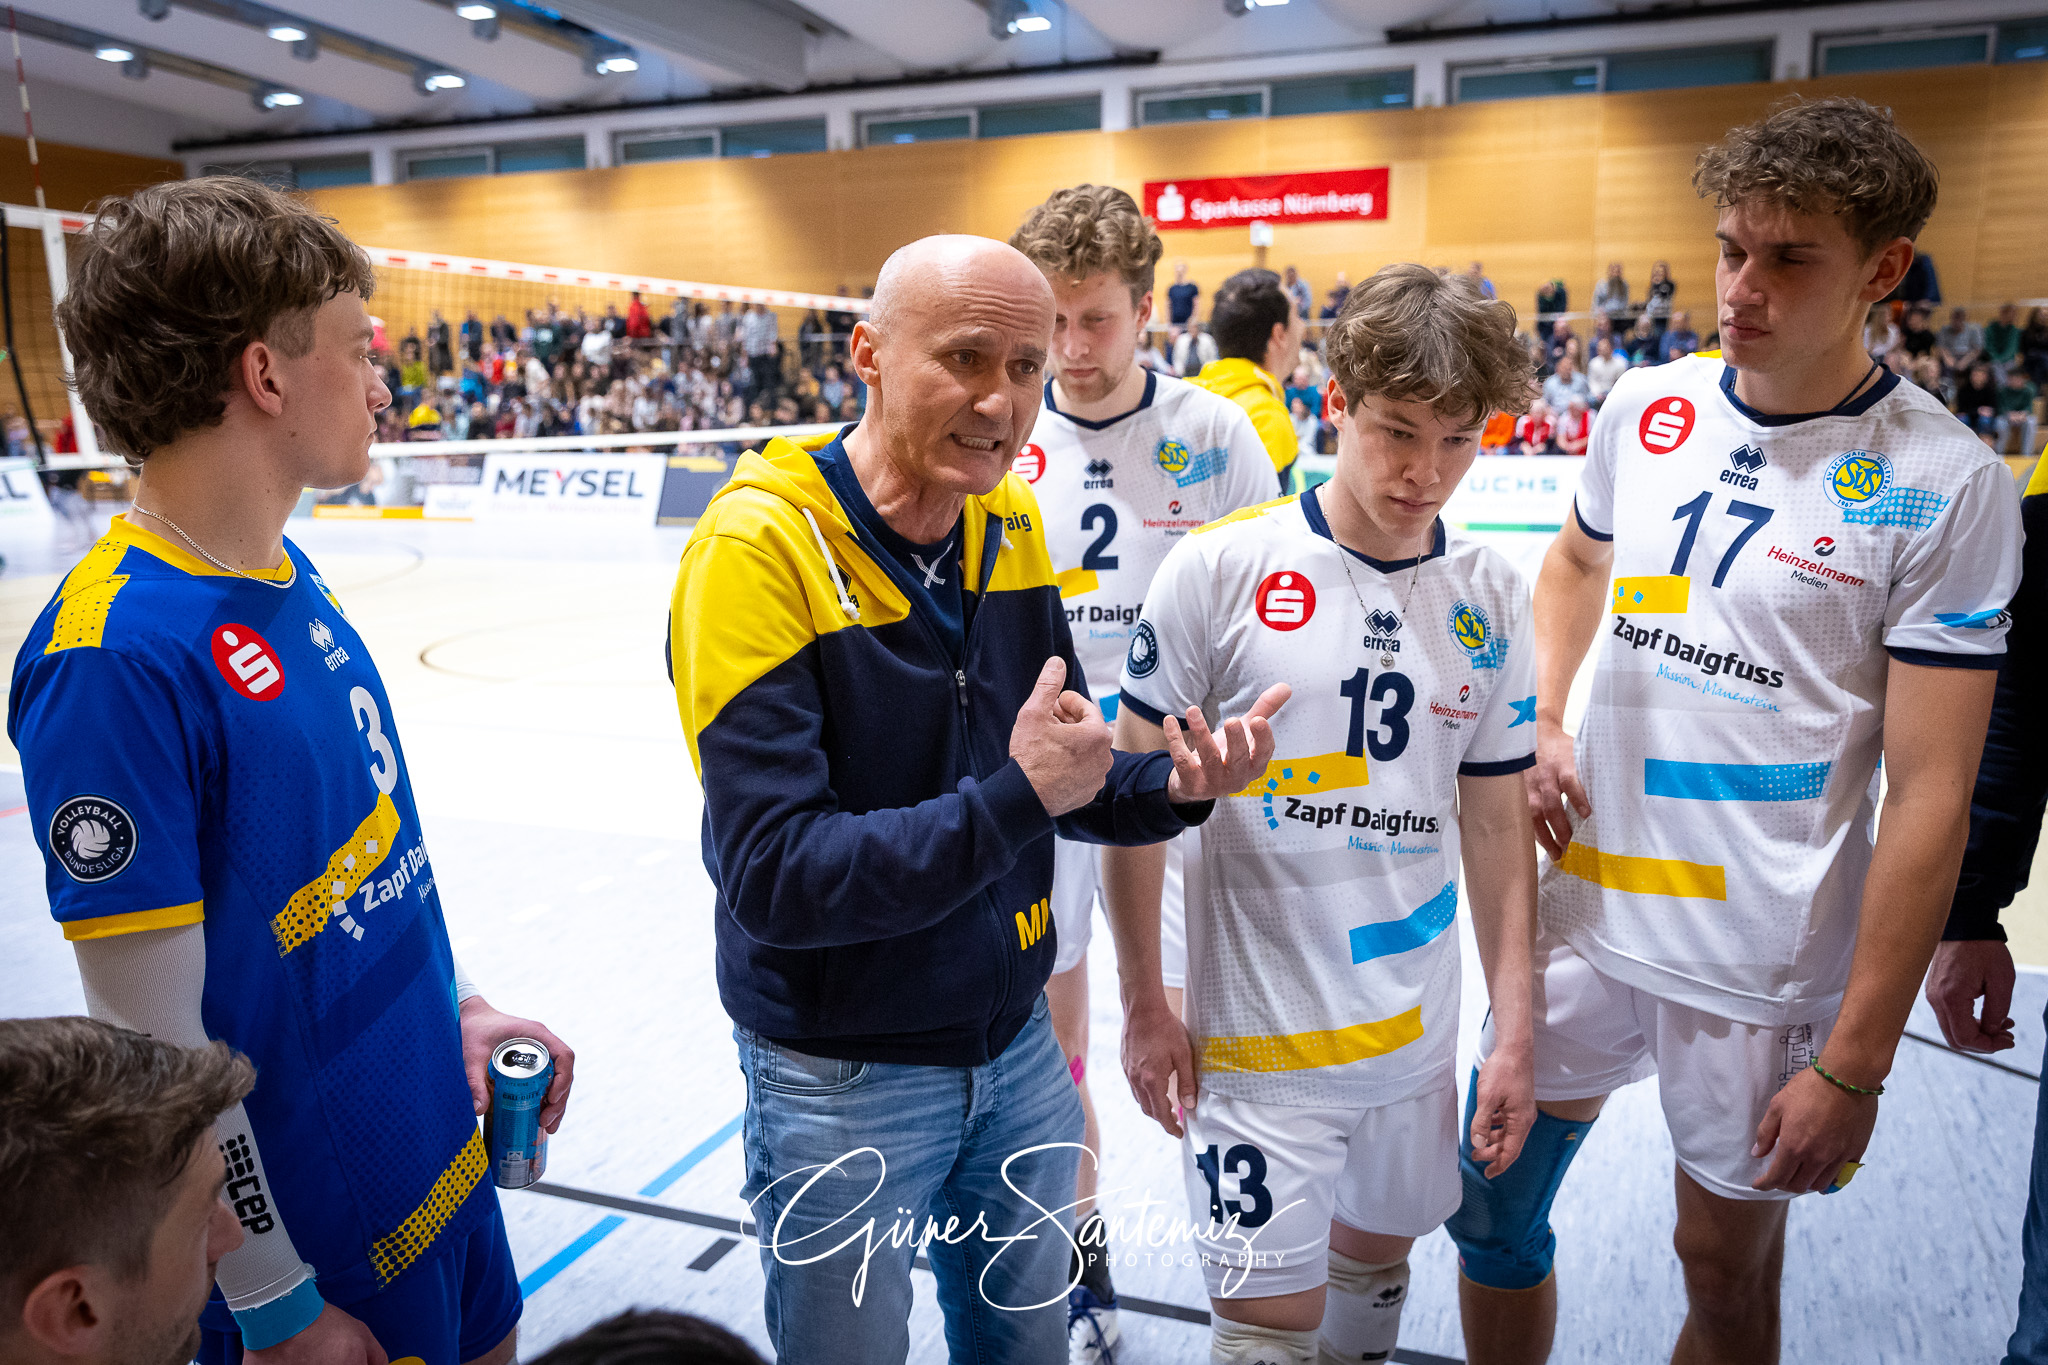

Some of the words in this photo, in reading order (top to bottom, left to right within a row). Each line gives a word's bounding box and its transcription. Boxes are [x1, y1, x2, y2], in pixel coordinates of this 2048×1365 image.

[1190, 196, 1282, 223] Sparkasse
[1283, 190, 1374, 216] Nürnberg
[493, 469, 645, 499] MEYSEL
[1084, 477, 1114, 490] errea
[1468, 476, 1557, 493] UCHS
[1719, 468, 1760, 492] errea
[1831, 451, 1867, 470] SCHWAIG
[1875, 456, 1892, 498] VOLLEYBALL
[1080, 503, 1119, 571] 2
[1669, 490, 1775, 589] 17
[1767, 545, 1865, 588] Heinzelmann
[1790, 570, 1829, 591] Medien
[1064, 605, 1085, 623] pf
[1089, 604, 1144, 625] Daigf
[324, 646, 351, 672] errea
[1613, 615, 1663, 650] Zapf
[1663, 633, 1785, 689] Daigfuss
[1340, 666, 1415, 762] 13
[350, 686, 398, 795] 3
[57, 805, 122, 835] VOLLEYBALL
[1285, 797, 1347, 829] Zapf
[64, 846, 126, 874] BUNDESLIGA
[358, 855, 412, 913] Zapf
[407, 836, 428, 876] Dai
[1195, 1143, 1273, 1229] 13
[226, 1175, 275, 1234] cep
